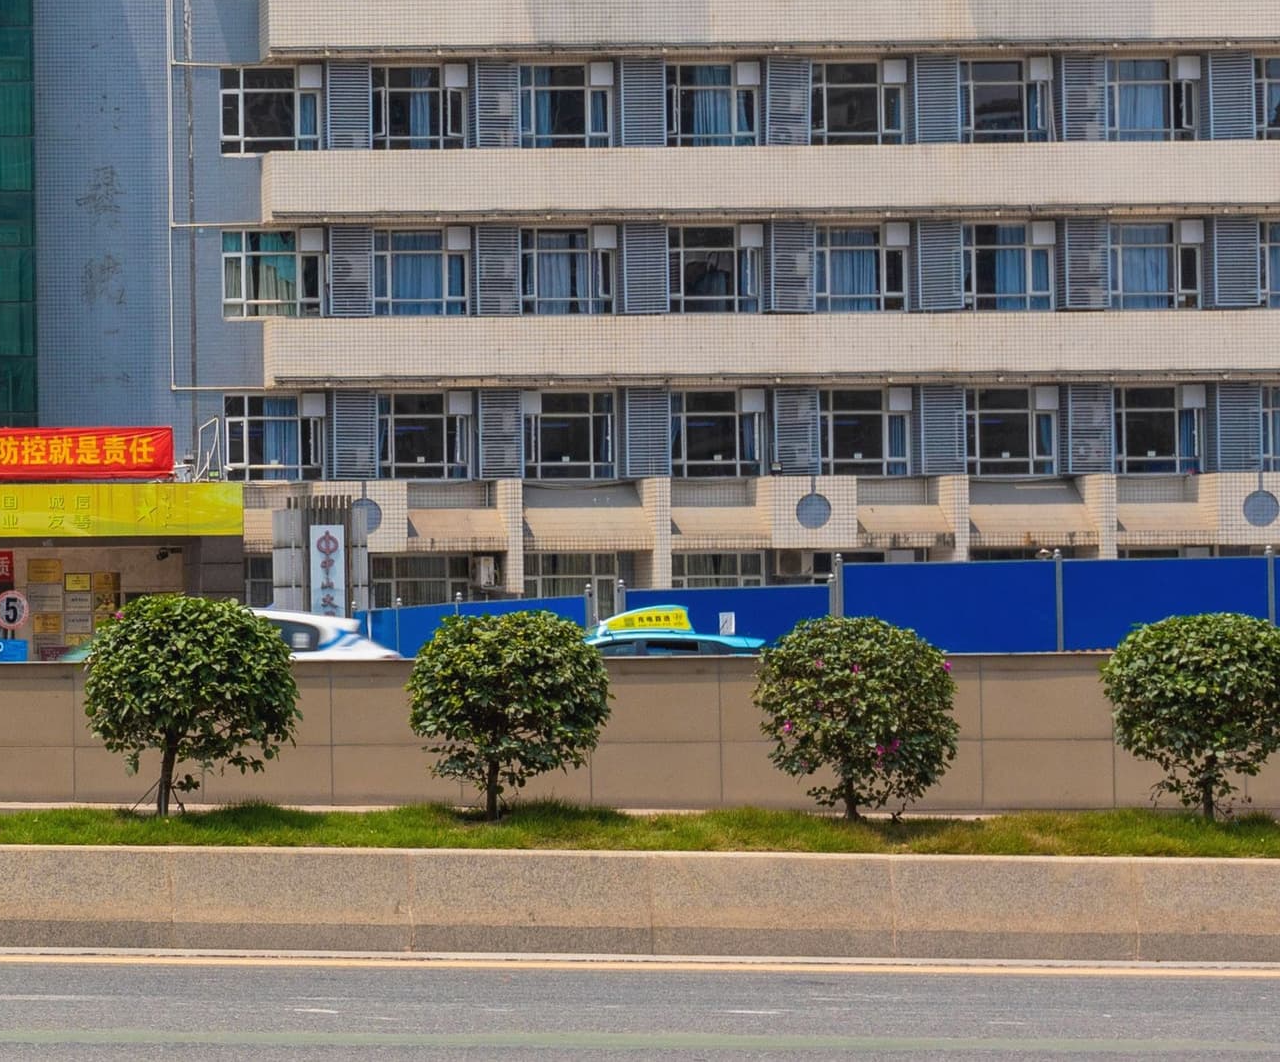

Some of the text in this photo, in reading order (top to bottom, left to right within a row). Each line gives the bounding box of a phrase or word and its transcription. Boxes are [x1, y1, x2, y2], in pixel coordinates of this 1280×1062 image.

[48, 496, 91, 510] 诚信
[48, 514, 91, 530] 友善
[5, 597, 18, 623] 5
